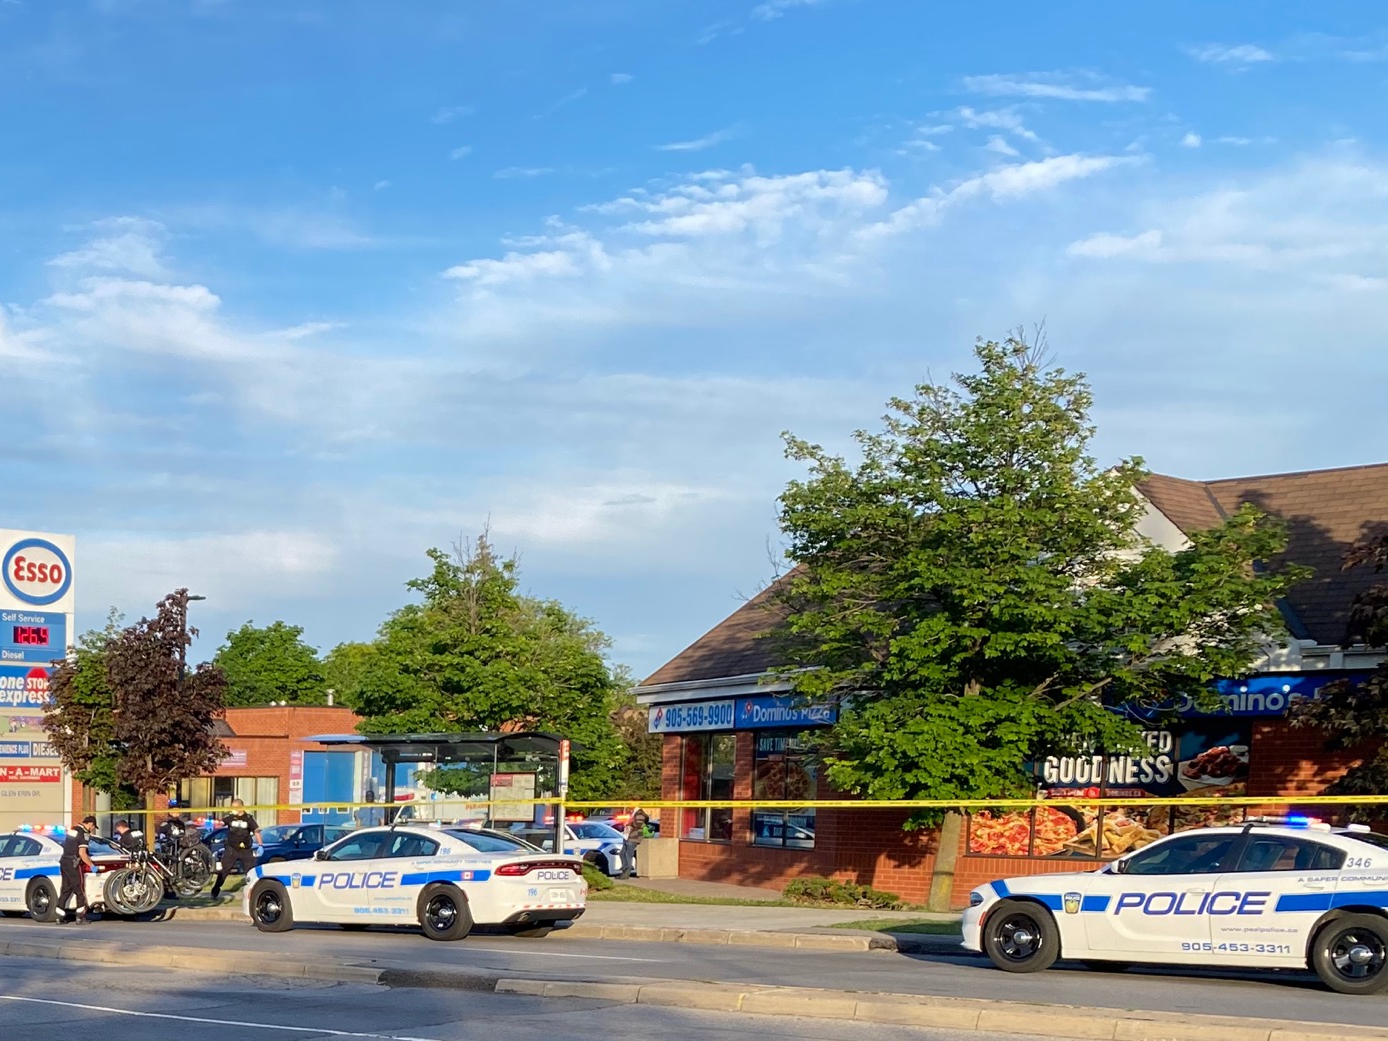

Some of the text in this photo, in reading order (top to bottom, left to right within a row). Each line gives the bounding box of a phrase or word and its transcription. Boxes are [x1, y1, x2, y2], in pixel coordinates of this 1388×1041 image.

[2, 613, 45, 623] Self Service
[17, 627, 49, 645] 126.9
[2, 650, 24, 659] Diesel
[665, 704, 732, 728] 905-569-9900
[1044, 755, 1171, 783] GOODNESS
[1347, 857, 1372, 868] 346
[318, 871, 398, 890] POLICE
[538, 871, 569, 880] POLICE
[1114, 891, 1271, 915] POLICE
[1182, 942, 1291, 954] 905-453-3311
